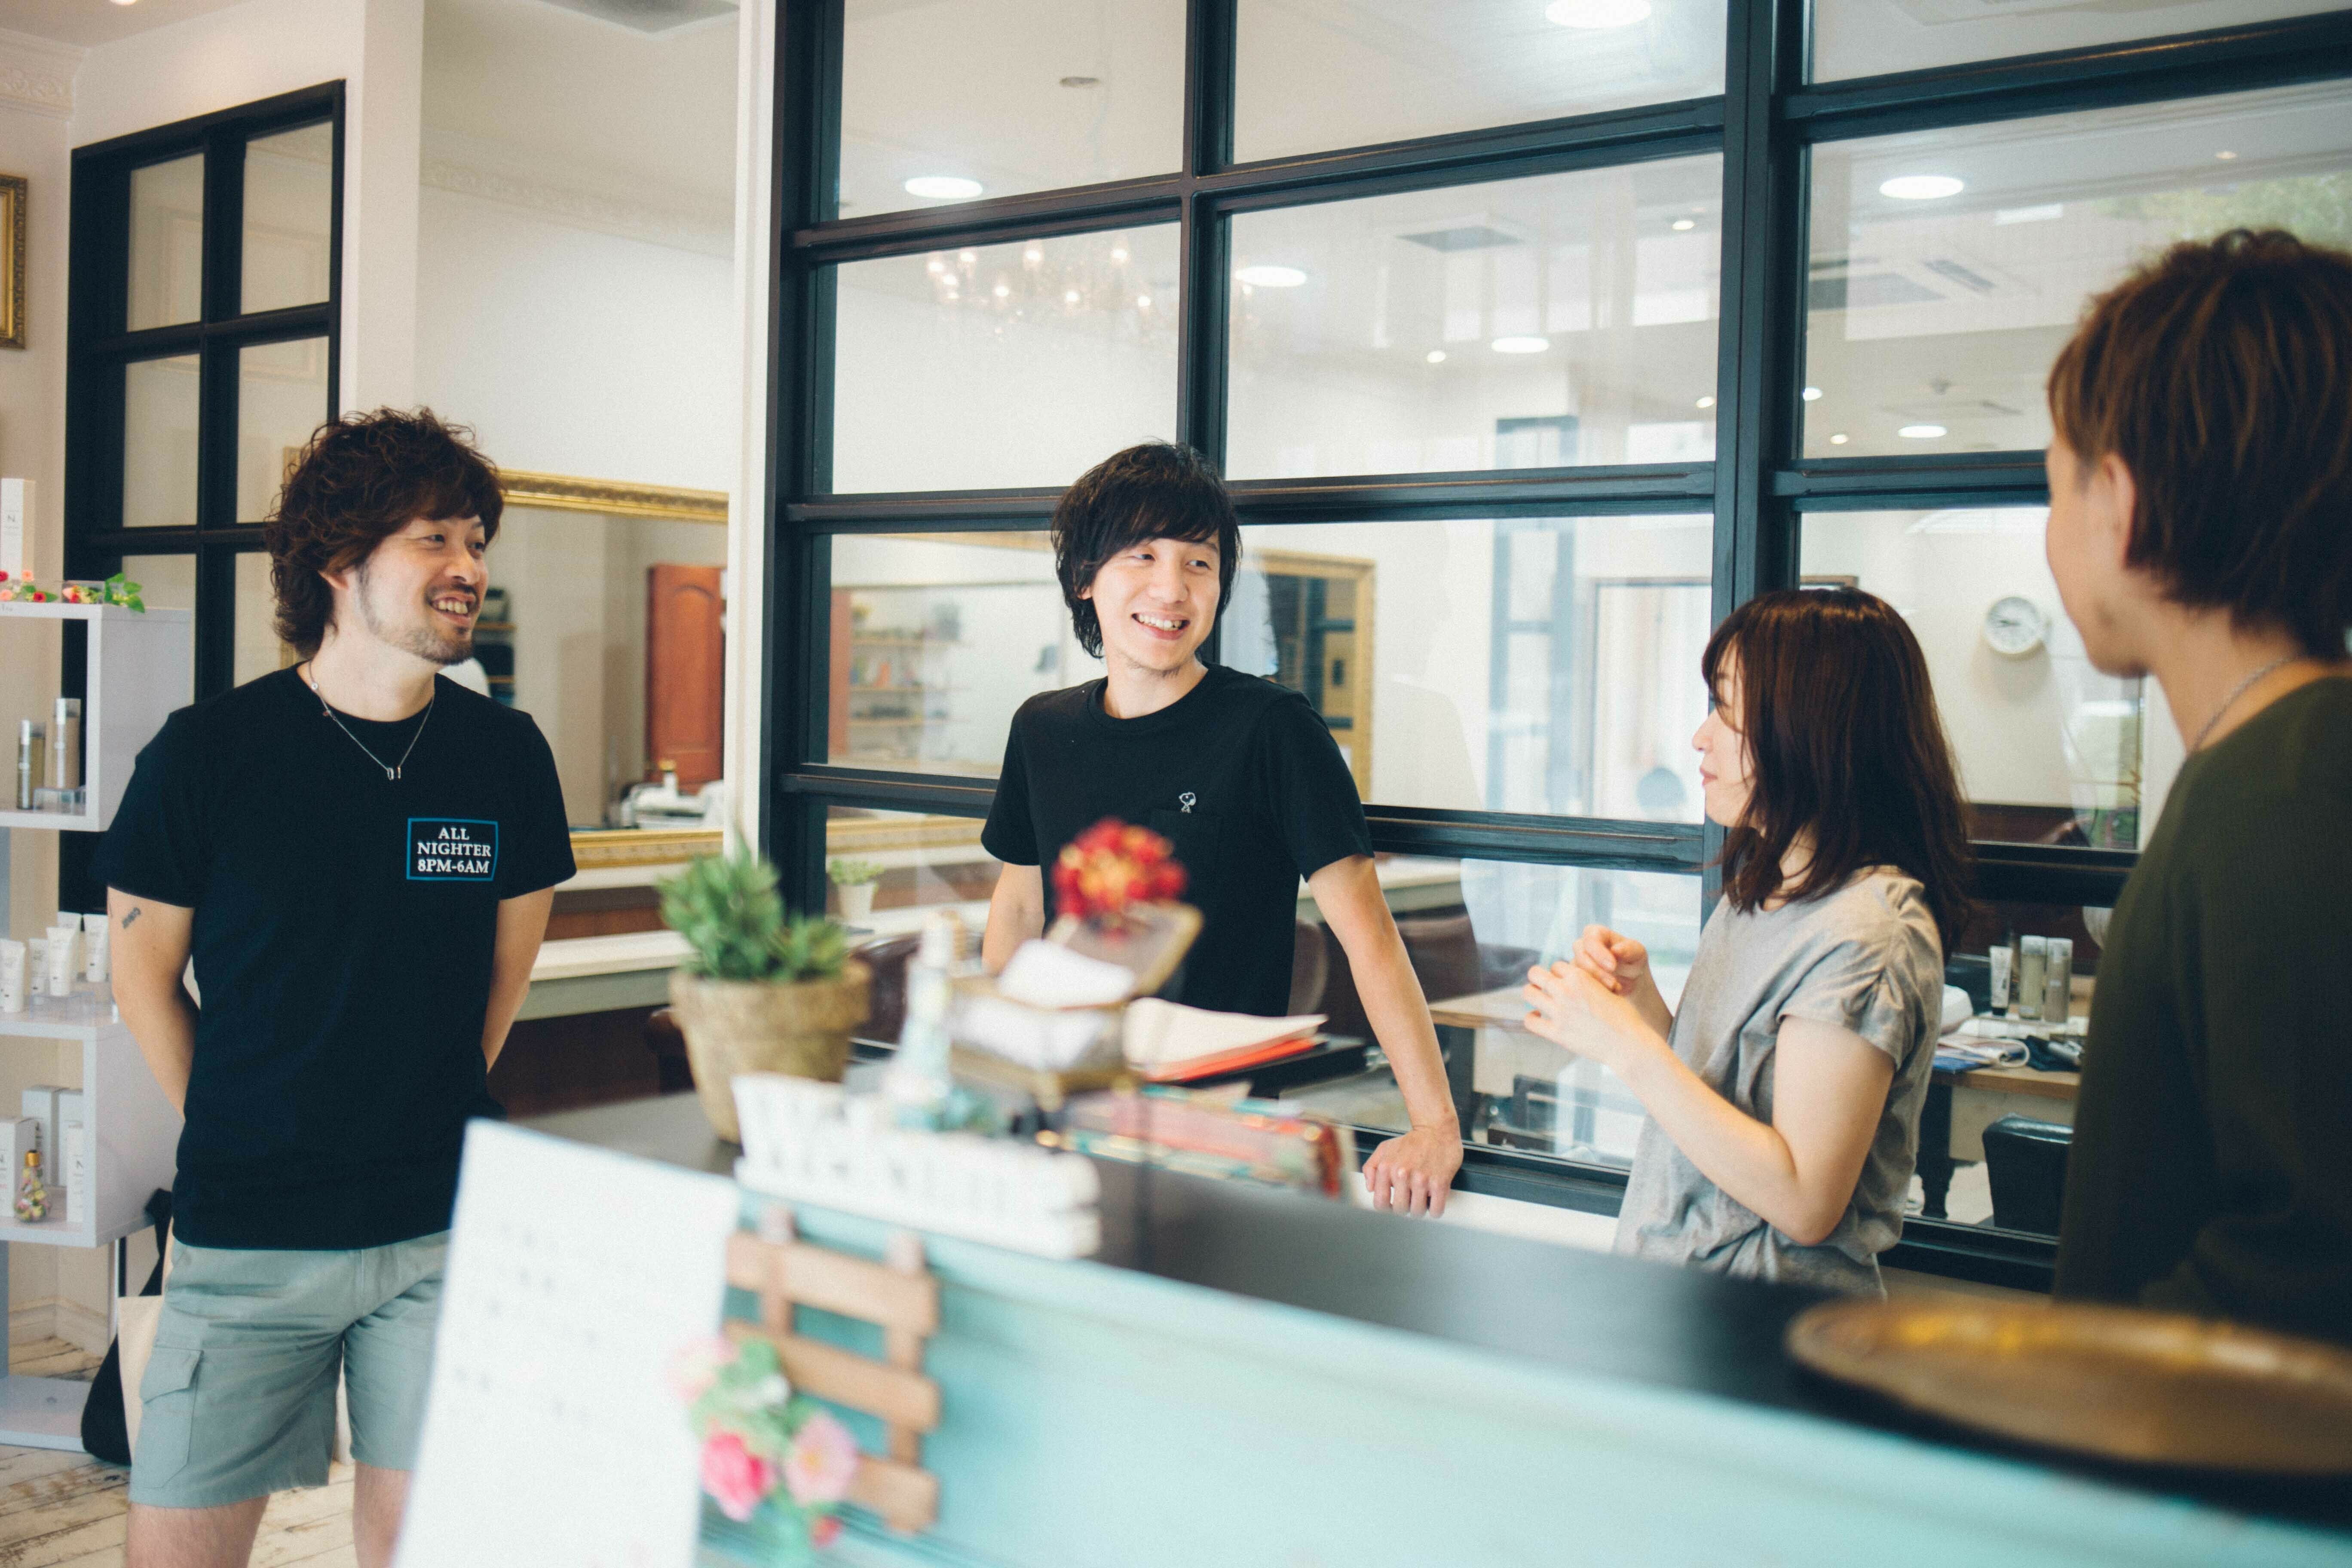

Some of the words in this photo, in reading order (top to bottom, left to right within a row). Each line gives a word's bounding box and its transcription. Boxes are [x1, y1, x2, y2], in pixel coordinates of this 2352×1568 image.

[438, 827, 470, 840] ALL
[417, 842, 492, 857] NIGHTER
[417, 858, 490, 873] 8PM-6AM
